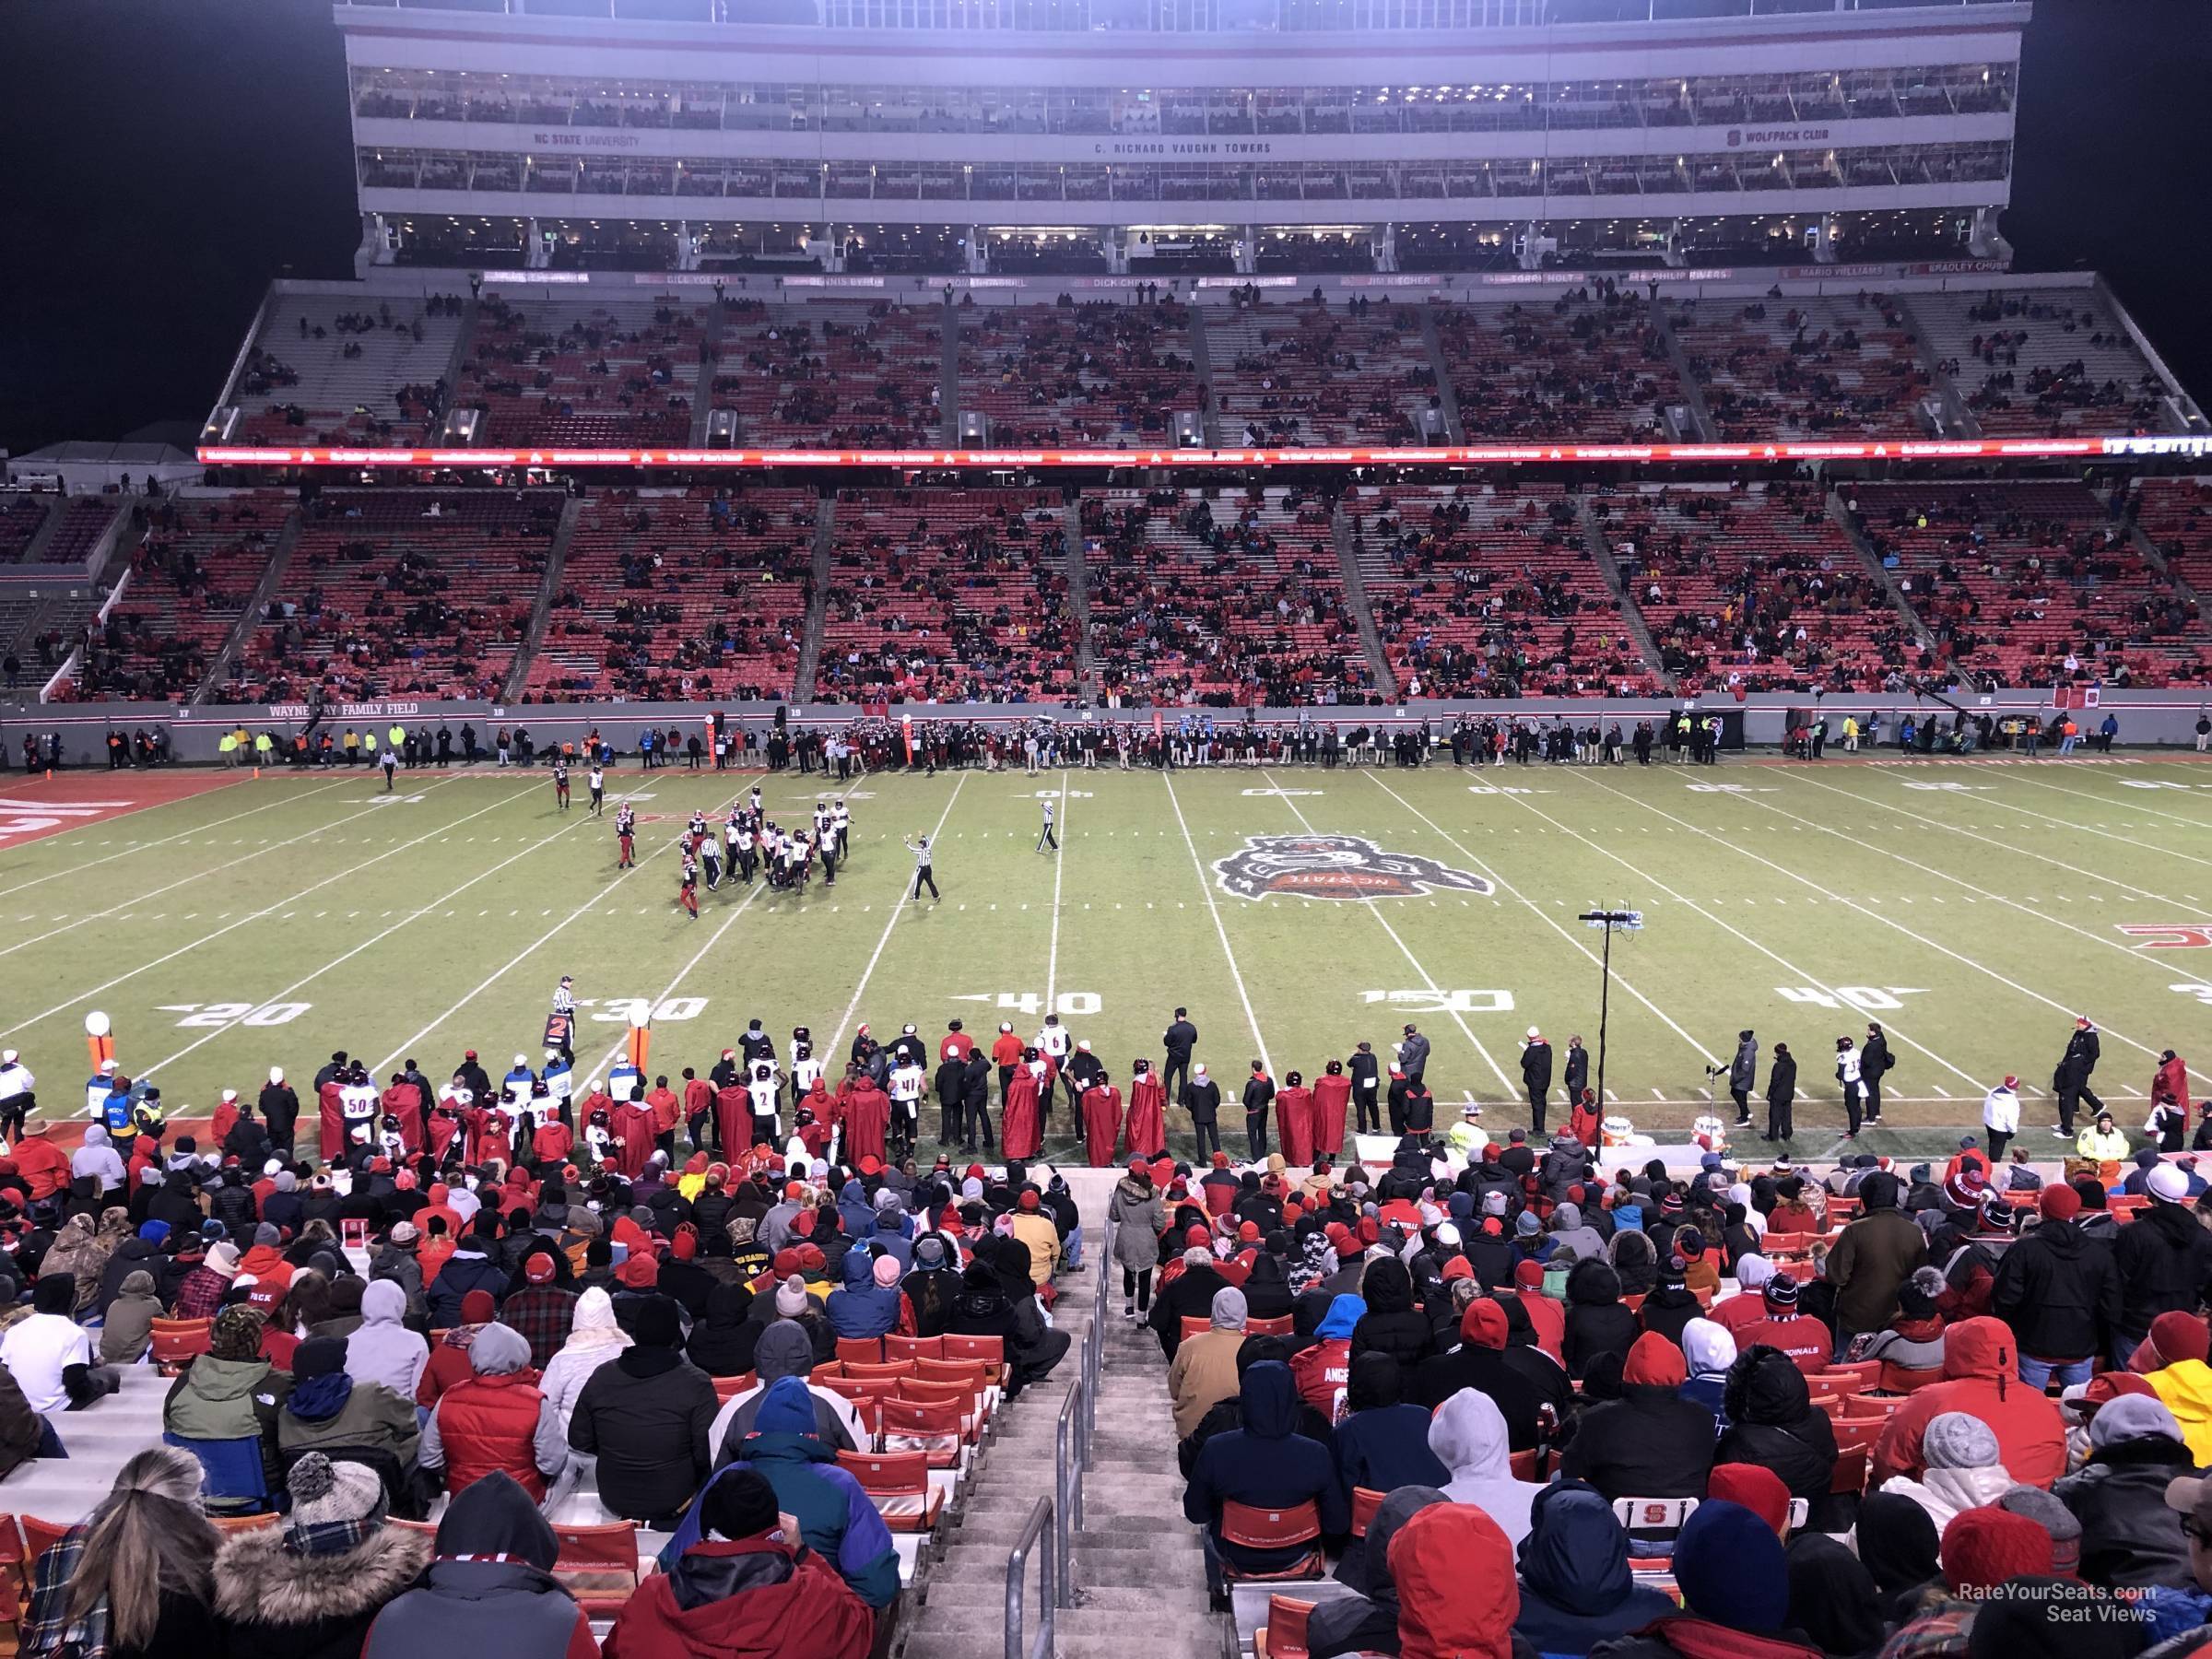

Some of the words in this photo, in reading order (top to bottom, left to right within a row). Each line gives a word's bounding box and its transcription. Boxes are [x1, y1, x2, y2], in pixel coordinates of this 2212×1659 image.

[535, 134, 548, 144] NC
[552, 135, 582, 145] STATE
[584, 135, 641, 147] UNIVERSITY
[1746, 131, 1799, 142] WOLFPACK
[1803, 129, 1829, 140] CLUB
[1114, 144, 1164, 154] RICHARD
[1172, 144, 1218, 153] VAUGHN
[1225, 143, 1271, 153] TOWERS
[1799, 267, 1832, 277] MARIO
[1093, 278, 1118, 288] DICK
[270, 706, 310, 717] WAYNE
[317, 705, 336, 715] AY
[342, 704, 383, 715] FAMILY
[387, 703, 418, 714] FIELD
[791, 709, 801, 717] 19
[1035, 790, 1094, 798] 40
[1290, 875, 1352, 884] STATE
[996, 992, 1101, 1016] 40
[1774, 985, 1903, 1010] 40
[176, 1002, 312, 1027] 20
[590, 997, 710, 1021] 30
[547, 1017, 568, 1037] 2
[1053, 1036, 1059, 1048] 6
[901, 1077, 915, 1092] 41
[759, 1091, 767, 1106] 2
[348, 1099, 367, 1113] 50
[250, 1292, 272, 1301] PACK
